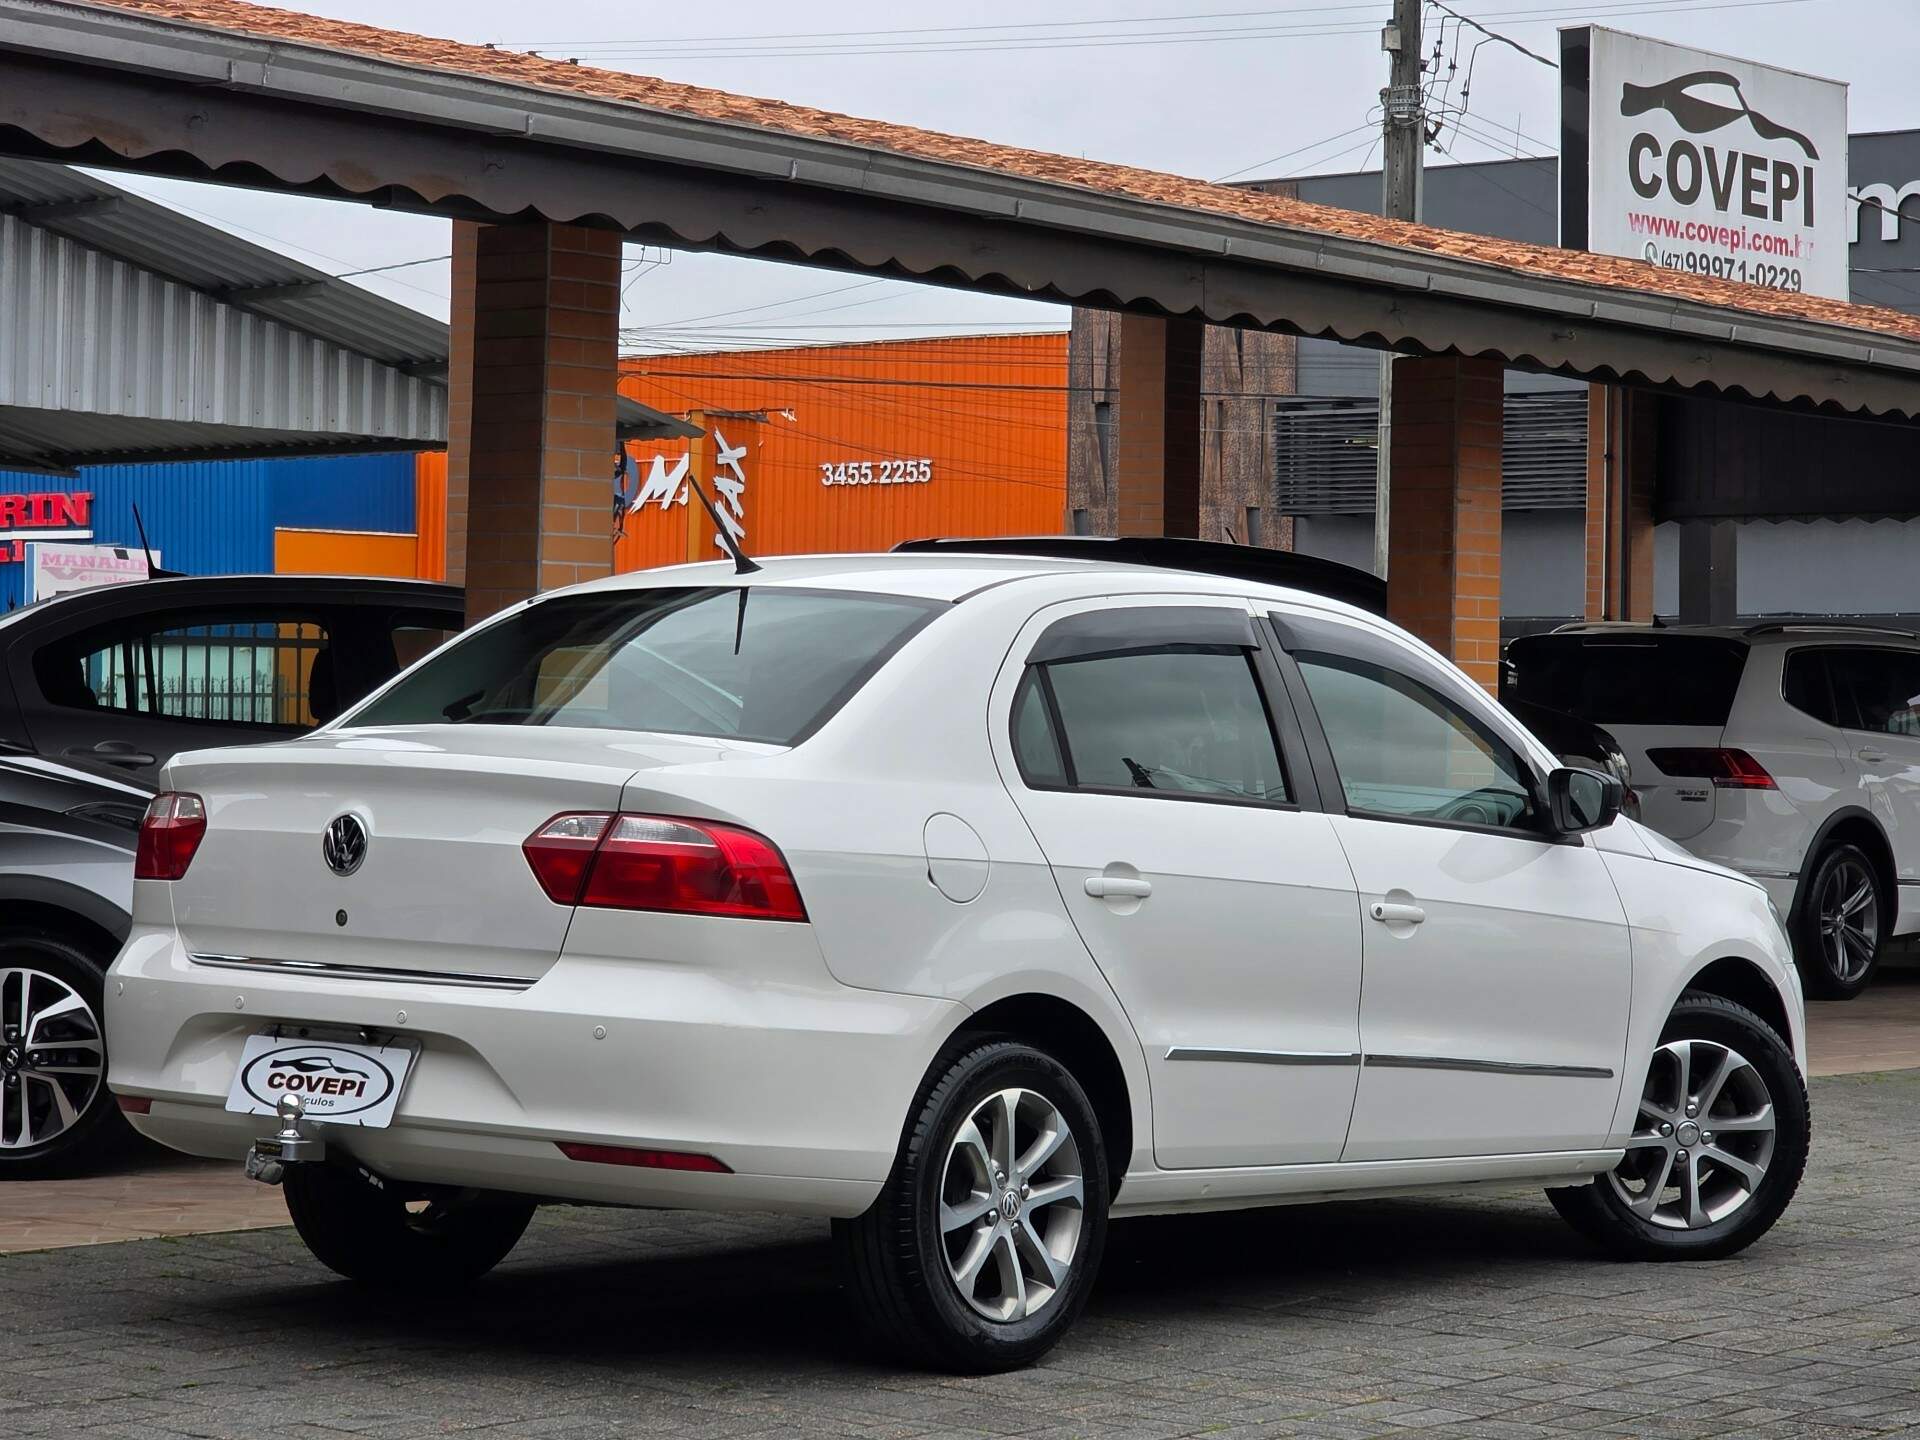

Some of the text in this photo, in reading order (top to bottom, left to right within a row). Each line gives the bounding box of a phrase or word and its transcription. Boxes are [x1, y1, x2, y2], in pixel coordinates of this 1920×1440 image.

[1628, 132, 1814, 228] COVEPI
[1628, 212, 1814, 259] www.covepi.com.b
[821, 459, 932, 486] 3455.2255
[267, 1072, 367, 1098] COVEPI
[303, 1096, 335, 1107] culos
